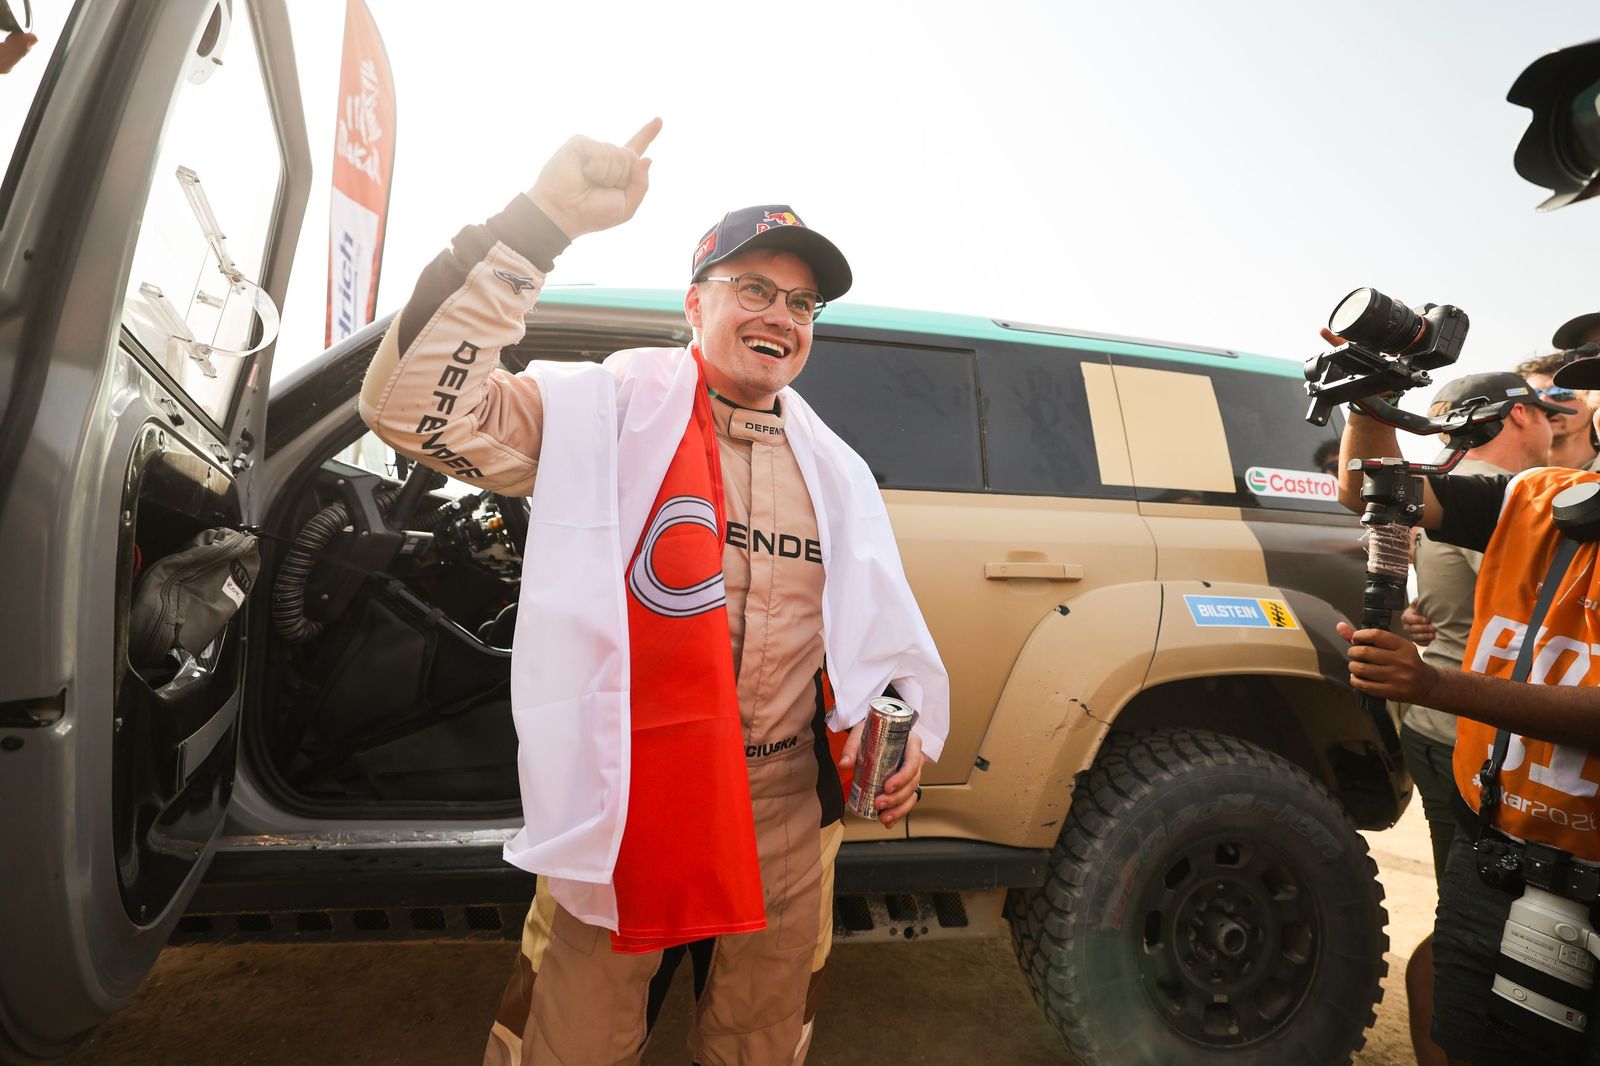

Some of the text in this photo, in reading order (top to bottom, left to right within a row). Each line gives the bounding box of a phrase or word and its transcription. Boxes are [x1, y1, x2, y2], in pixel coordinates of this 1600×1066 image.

[1270, 474, 1336, 496] Castrol
[1196, 604, 1259, 619] BILSTEIN
[744, 735, 798, 758] CIUSKA
